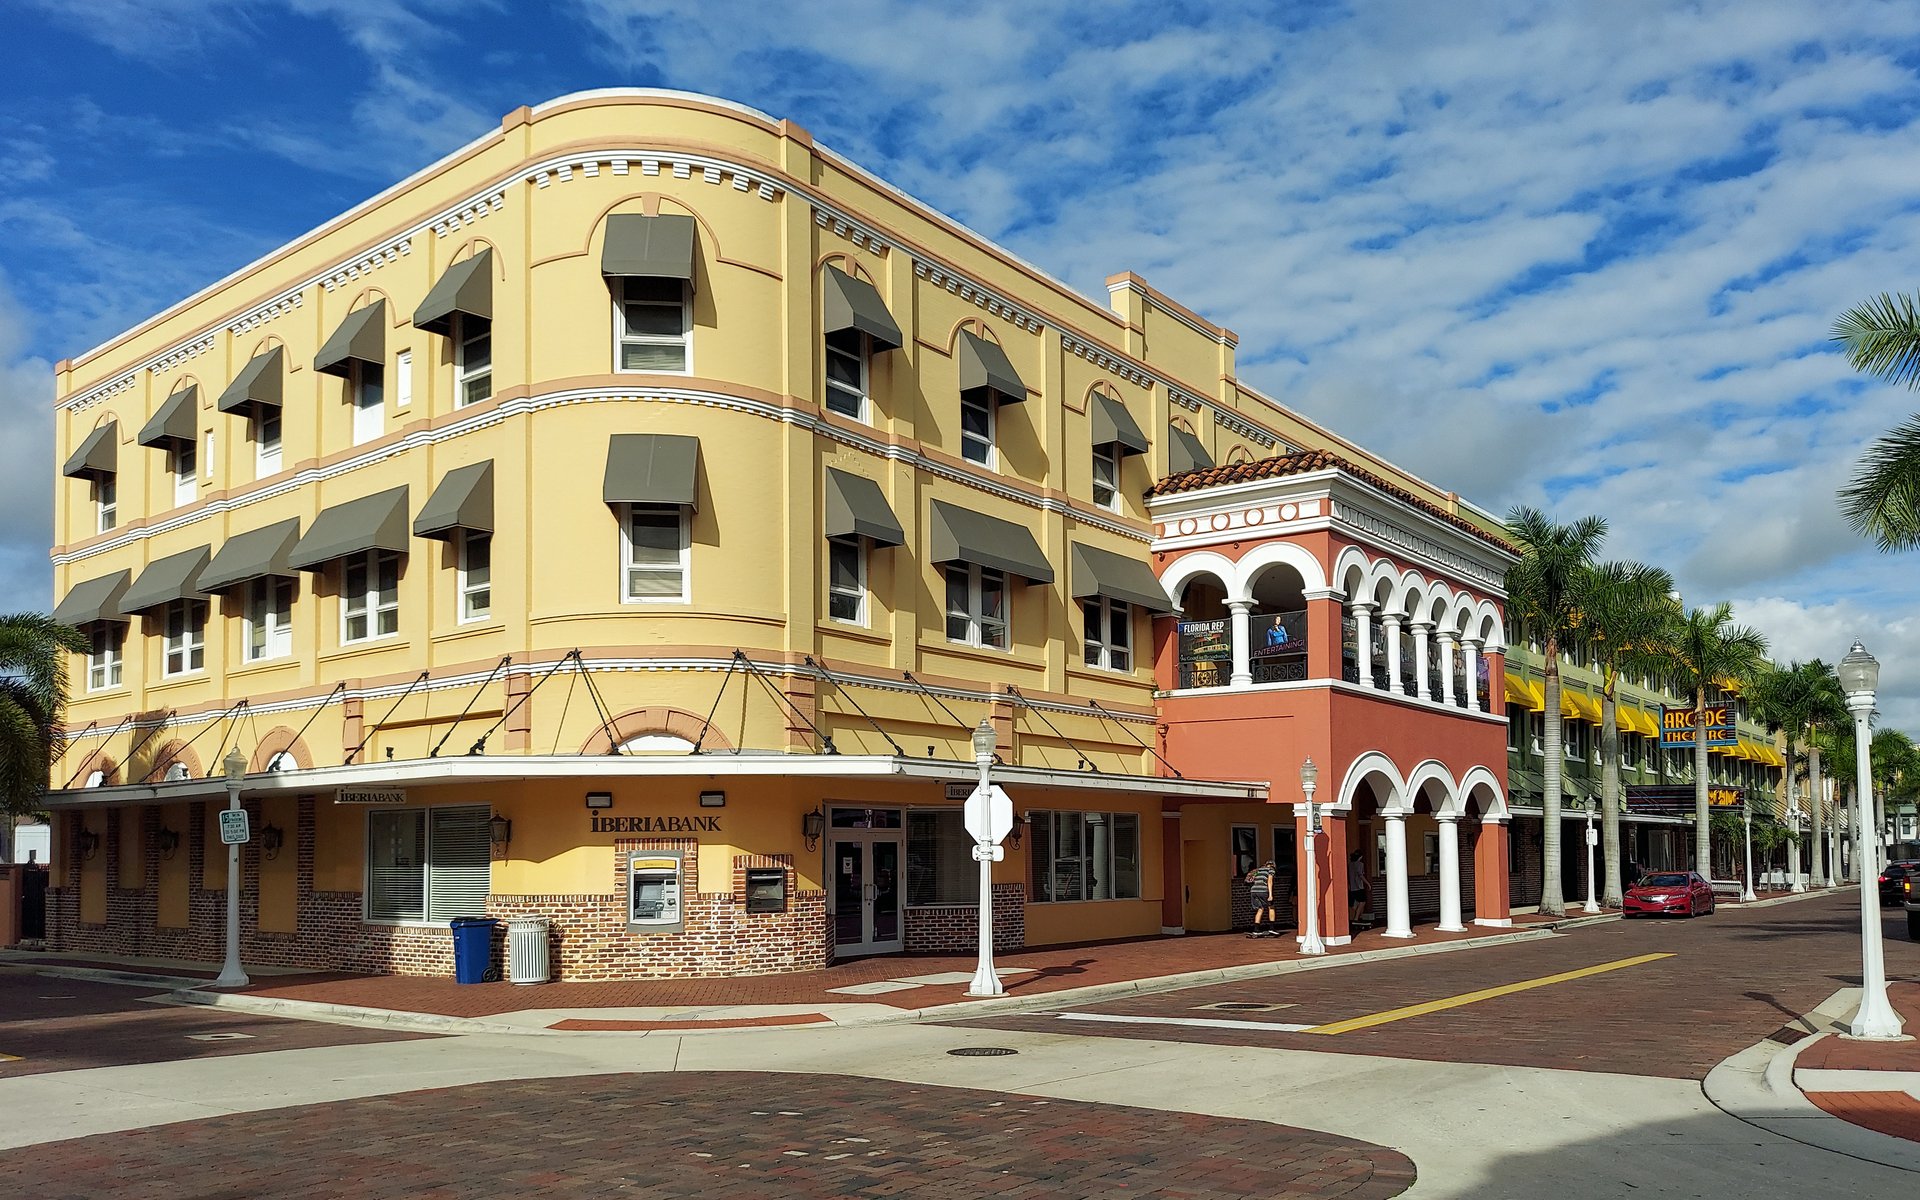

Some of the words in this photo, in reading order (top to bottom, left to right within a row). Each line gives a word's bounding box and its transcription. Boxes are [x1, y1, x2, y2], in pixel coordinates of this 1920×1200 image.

[1183, 623, 1210, 633] FLORIDA
[1211, 621, 1225, 631] REP
[1253, 639, 1305, 657] ENTERTAINING!
[1664, 709, 1726, 729] ARCDE
